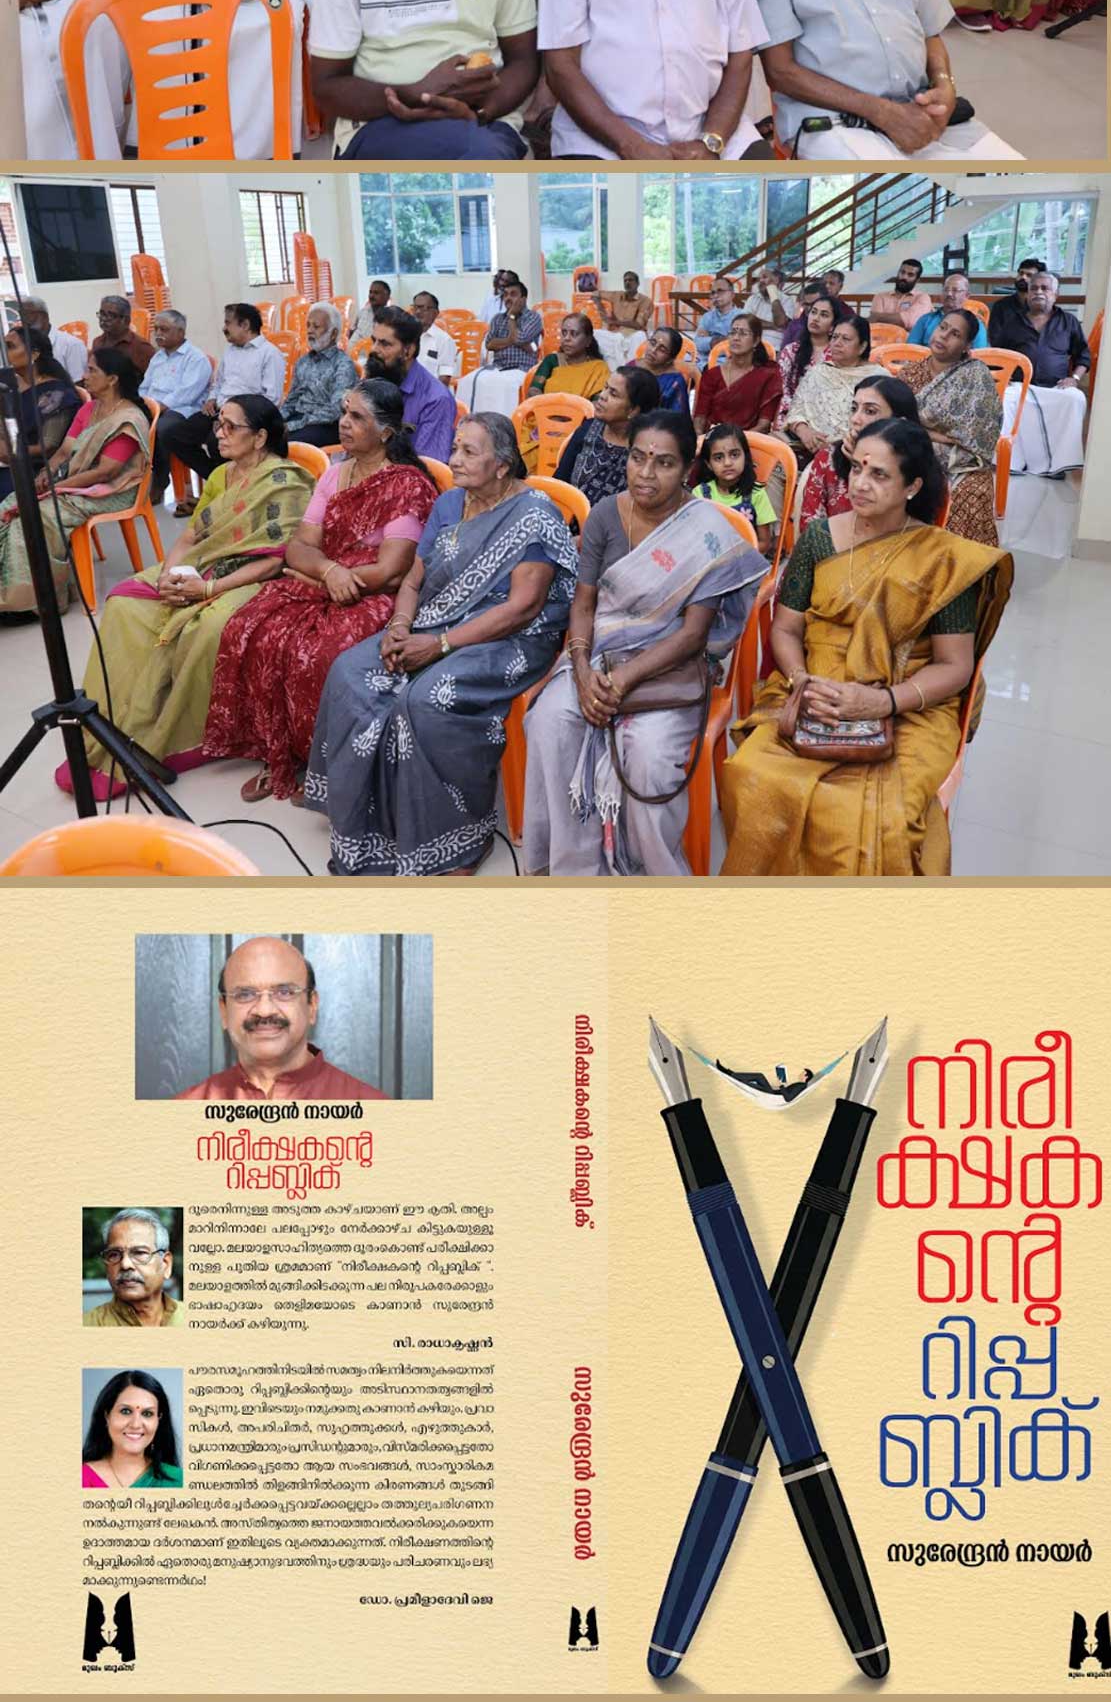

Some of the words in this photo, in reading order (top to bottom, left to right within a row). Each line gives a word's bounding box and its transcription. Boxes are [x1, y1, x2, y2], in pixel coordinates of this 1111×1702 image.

[570, 1015, 594, 1139] നിരീക്ഷകന്റെ
[205, 1102, 299, 1123] സുരേന്ദ്രൻ
[304, 1102, 363, 1119] നായർ
[197, 1129, 373, 1168] നിരീക്ഷകന്റെ
[227, 1161, 343, 1200] റിപ്പബ്ലിക്
[403, 1206, 424, 1216] ഈ
[227, 1260, 269, 1274] പുതിയ
[367, 1299, 422, 1310] കാണാൻ
[393, 1336, 415, 1348] സി.
[362, 1402, 415, 1413] കാണാൻ
[570, 1367, 596, 1481] സുരേന്ദ്രൻ
[303, 1462, 335, 1472] ആയ
[574, 1488, 596, 1560] നായർ
[887, 1538, 1009, 1567] സുരേന്ദ്രൻ
[1016, 1539, 1092, 1562] നായർ
[360, 1596, 392, 1605] ഡോ.
[394, 1593, 469, 1607] പ്രമീളാദേവി
[471, 1596, 493, 1605] ജെ
